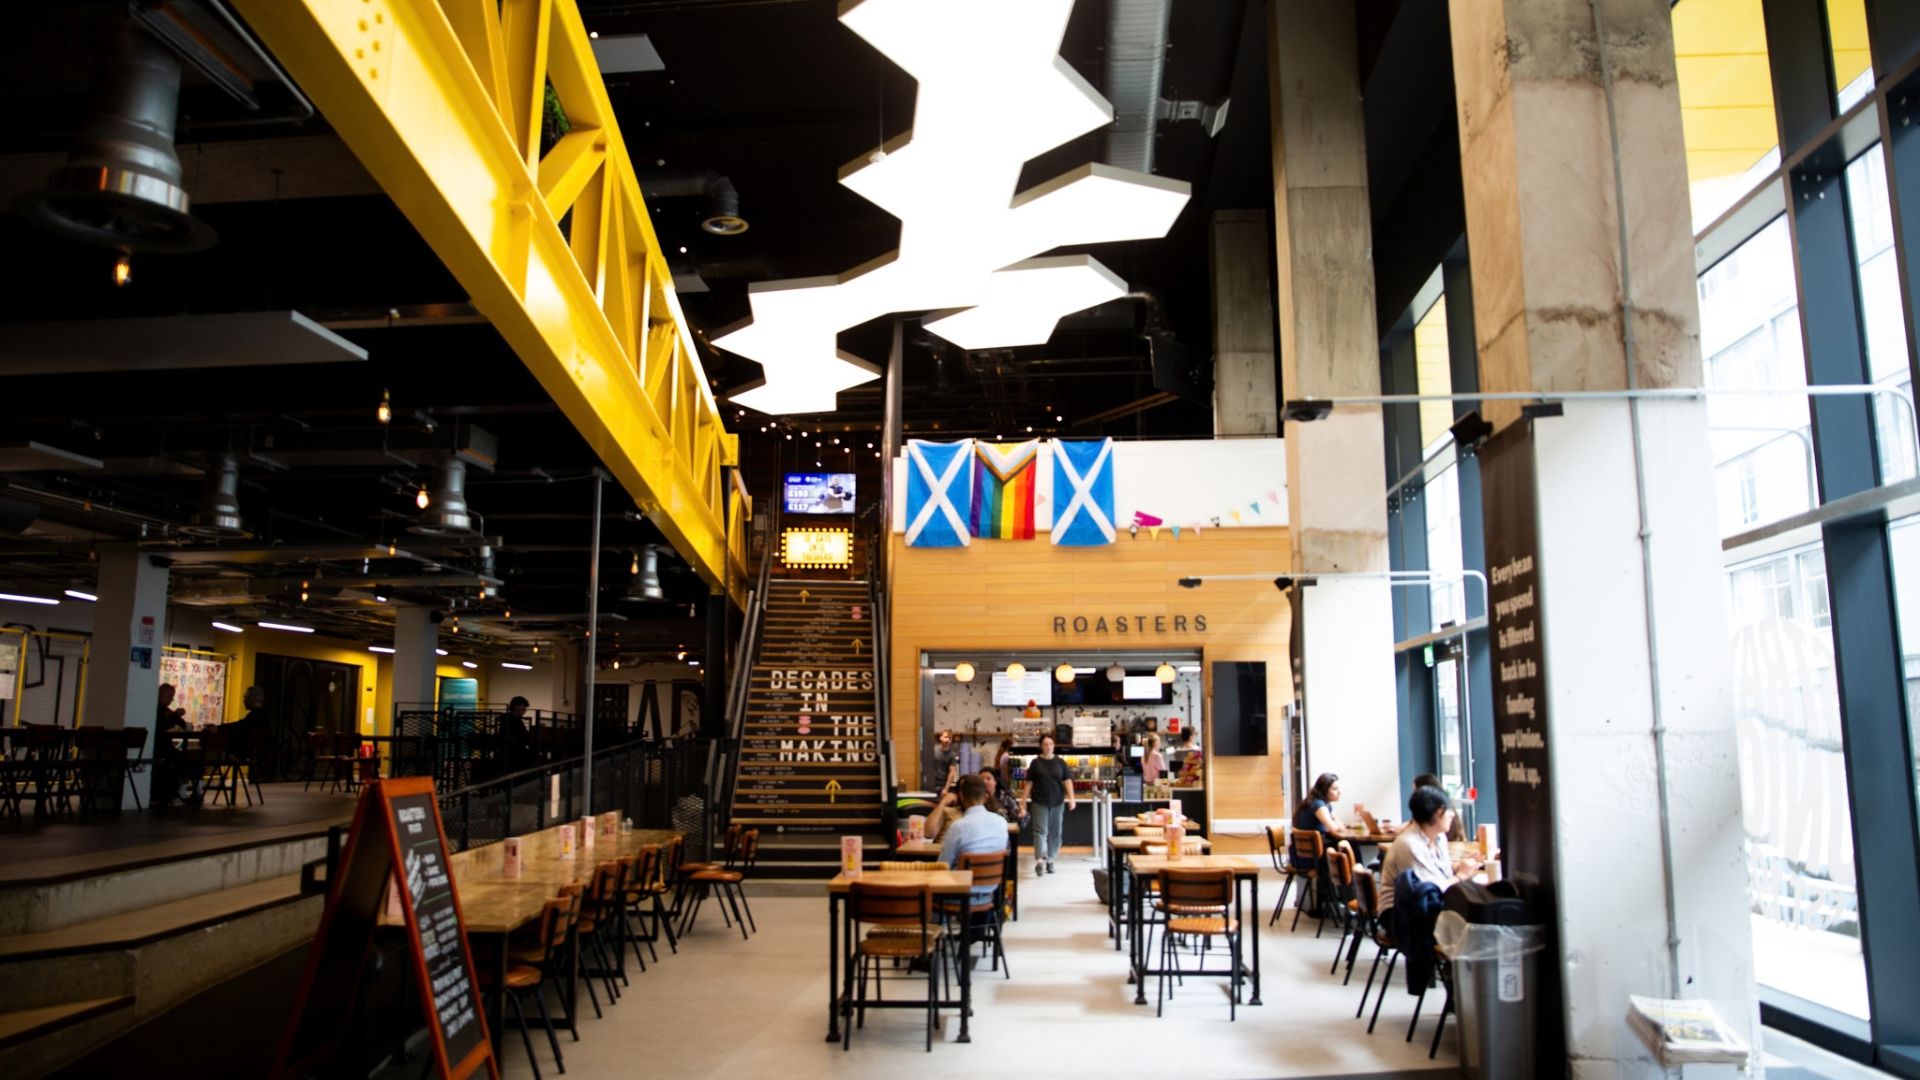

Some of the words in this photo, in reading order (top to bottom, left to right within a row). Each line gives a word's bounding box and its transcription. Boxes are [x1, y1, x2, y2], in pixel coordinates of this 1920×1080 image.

[1491, 564, 1513, 585] Every
[1512, 555, 1533, 577] bean
[1495, 600, 1511, 622] you
[1510, 585, 1534, 618] spend
[1053, 614, 1207, 634] ROASTERS
[1499, 630, 1507, 649] is
[1506, 620, 1535, 647] filtered
[770, 670, 873, 690] DECADES
[1500, 660, 1517, 682] back
[1517, 659, 1527, 679] in
[1526, 658, 1537, 678] to
[800, 692, 828, 712] IN
[830, 715, 875, 736] THE
[1516, 728, 1545, 749] Union.
[780, 739, 876, 762] MAKING
[1507, 762, 1526, 782] Drink
